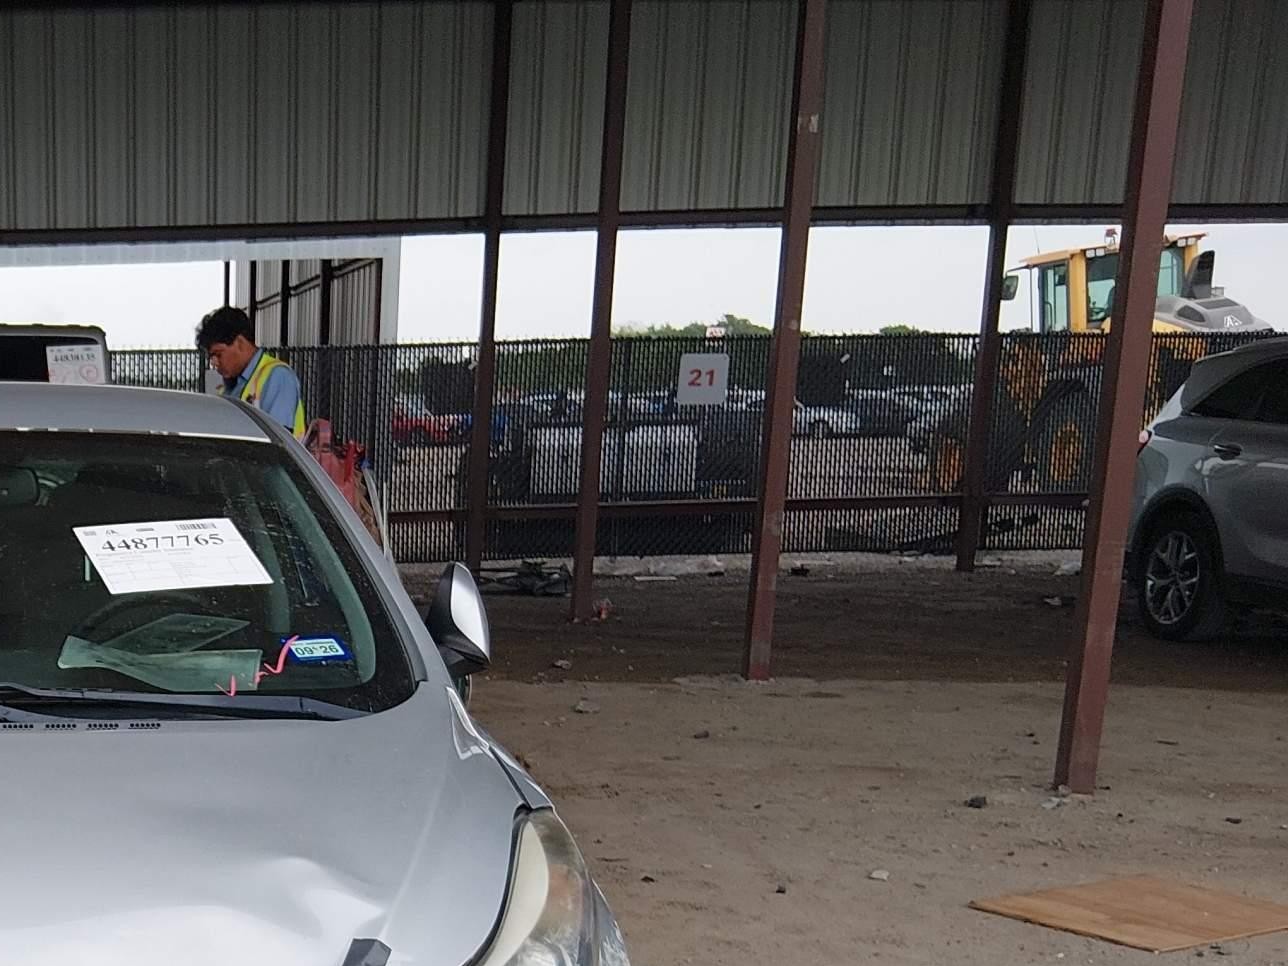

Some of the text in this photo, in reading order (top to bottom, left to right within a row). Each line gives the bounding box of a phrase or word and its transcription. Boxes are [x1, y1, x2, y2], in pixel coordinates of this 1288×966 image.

[687, 368, 715, 387] 21
[101, 532, 225, 552] 44877765
[295, 645, 340, 656] 09 26
